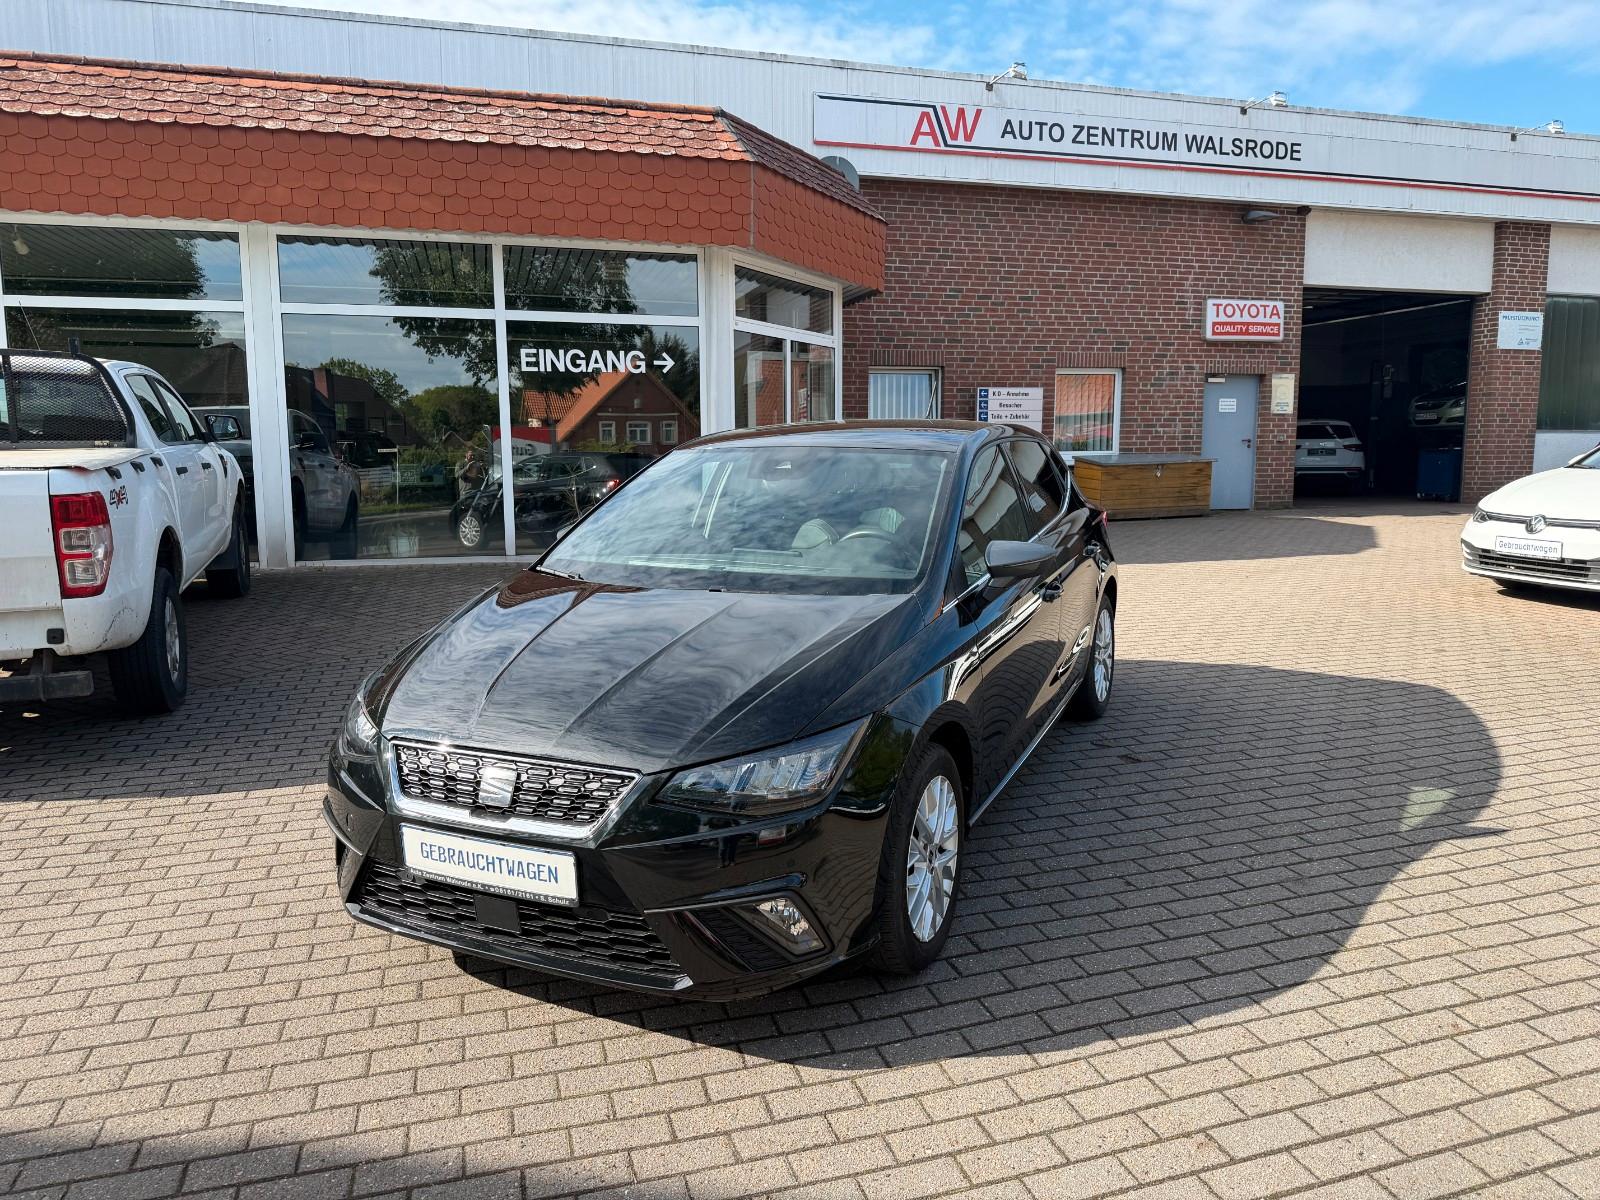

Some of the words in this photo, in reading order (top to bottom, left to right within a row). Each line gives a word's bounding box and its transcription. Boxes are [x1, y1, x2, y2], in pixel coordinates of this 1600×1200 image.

[1000, 118, 1065, 143] AUTO
[1071, 124, 1178, 152] ZENTRUM
[1184, 134, 1303, 162] WALSRODE
[1212, 303, 1281, 319] TOYOTA
[1214, 325, 1247, 333] QUALITY
[1248, 325, 1279, 334] SERVICE
[520, 348, 646, 374] EINGANG
[1499, 540, 1558, 555] Gebrauchtwagen
[420, 841, 559, 884] GEBRAUCHTWAGEN
